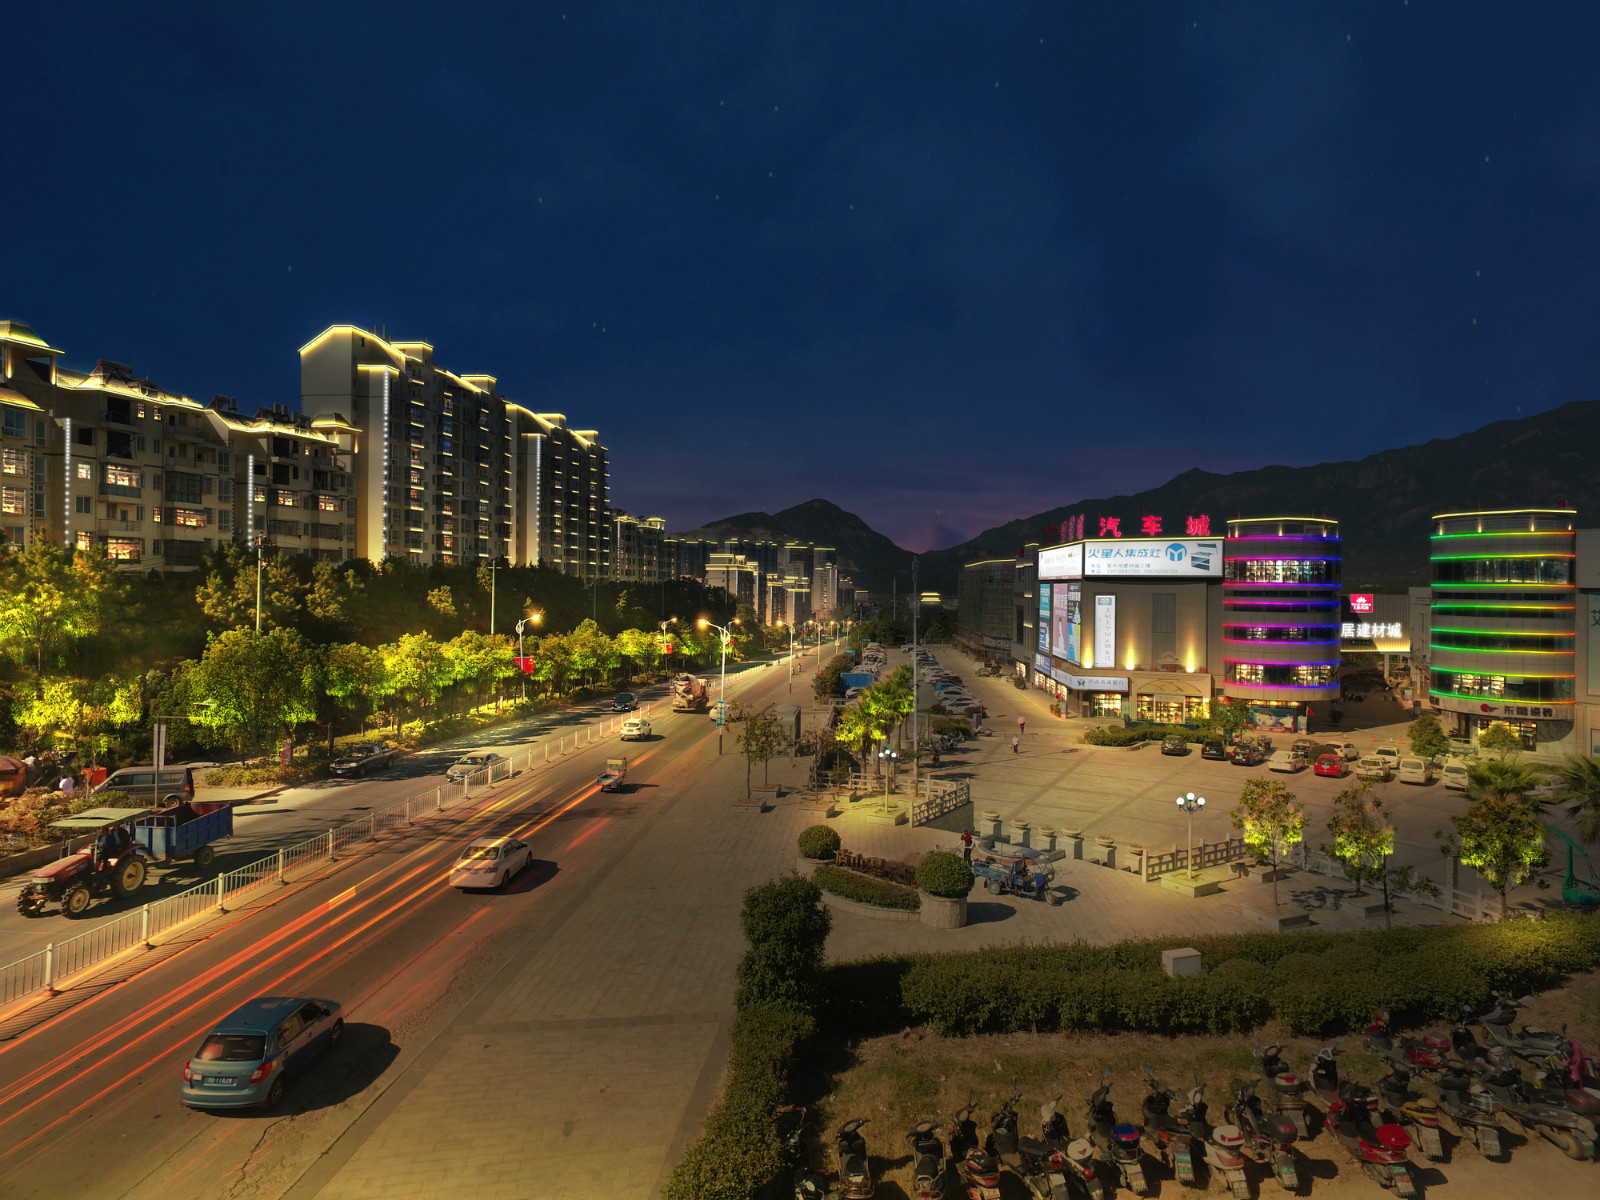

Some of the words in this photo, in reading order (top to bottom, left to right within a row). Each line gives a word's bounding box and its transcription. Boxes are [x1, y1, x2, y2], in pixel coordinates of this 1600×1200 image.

[1099, 514, 1211, 538] 汽车城
[1088, 548, 1162, 559] 火星人集成灶
[1341, 622, 1402, 638] 居建材城
